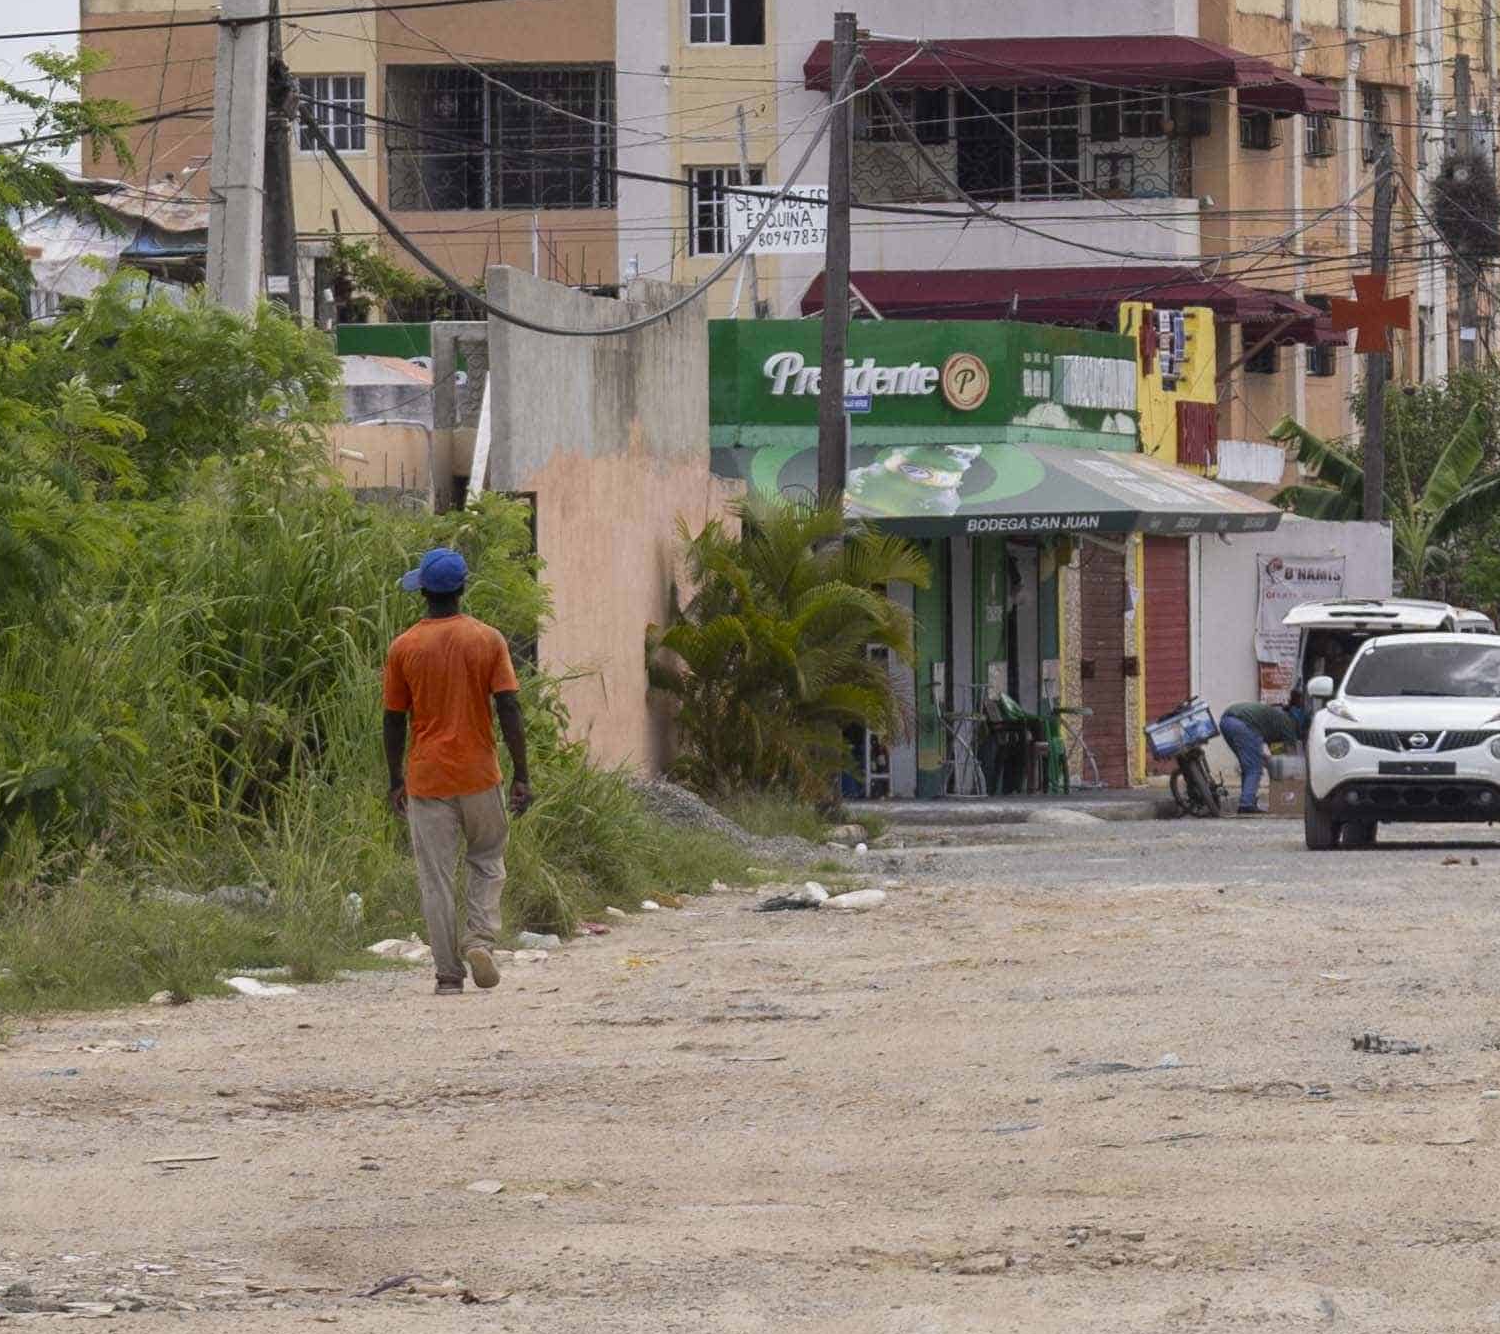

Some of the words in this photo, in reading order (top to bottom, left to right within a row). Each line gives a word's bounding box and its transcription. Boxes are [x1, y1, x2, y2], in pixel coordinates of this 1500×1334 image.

[763, 351, 940, 396] Preidente
[967, 518, 1028, 532] BODEGA
[1030, 516, 1061, 530] SAN
[1062, 515, 1100, 529] JUAN
